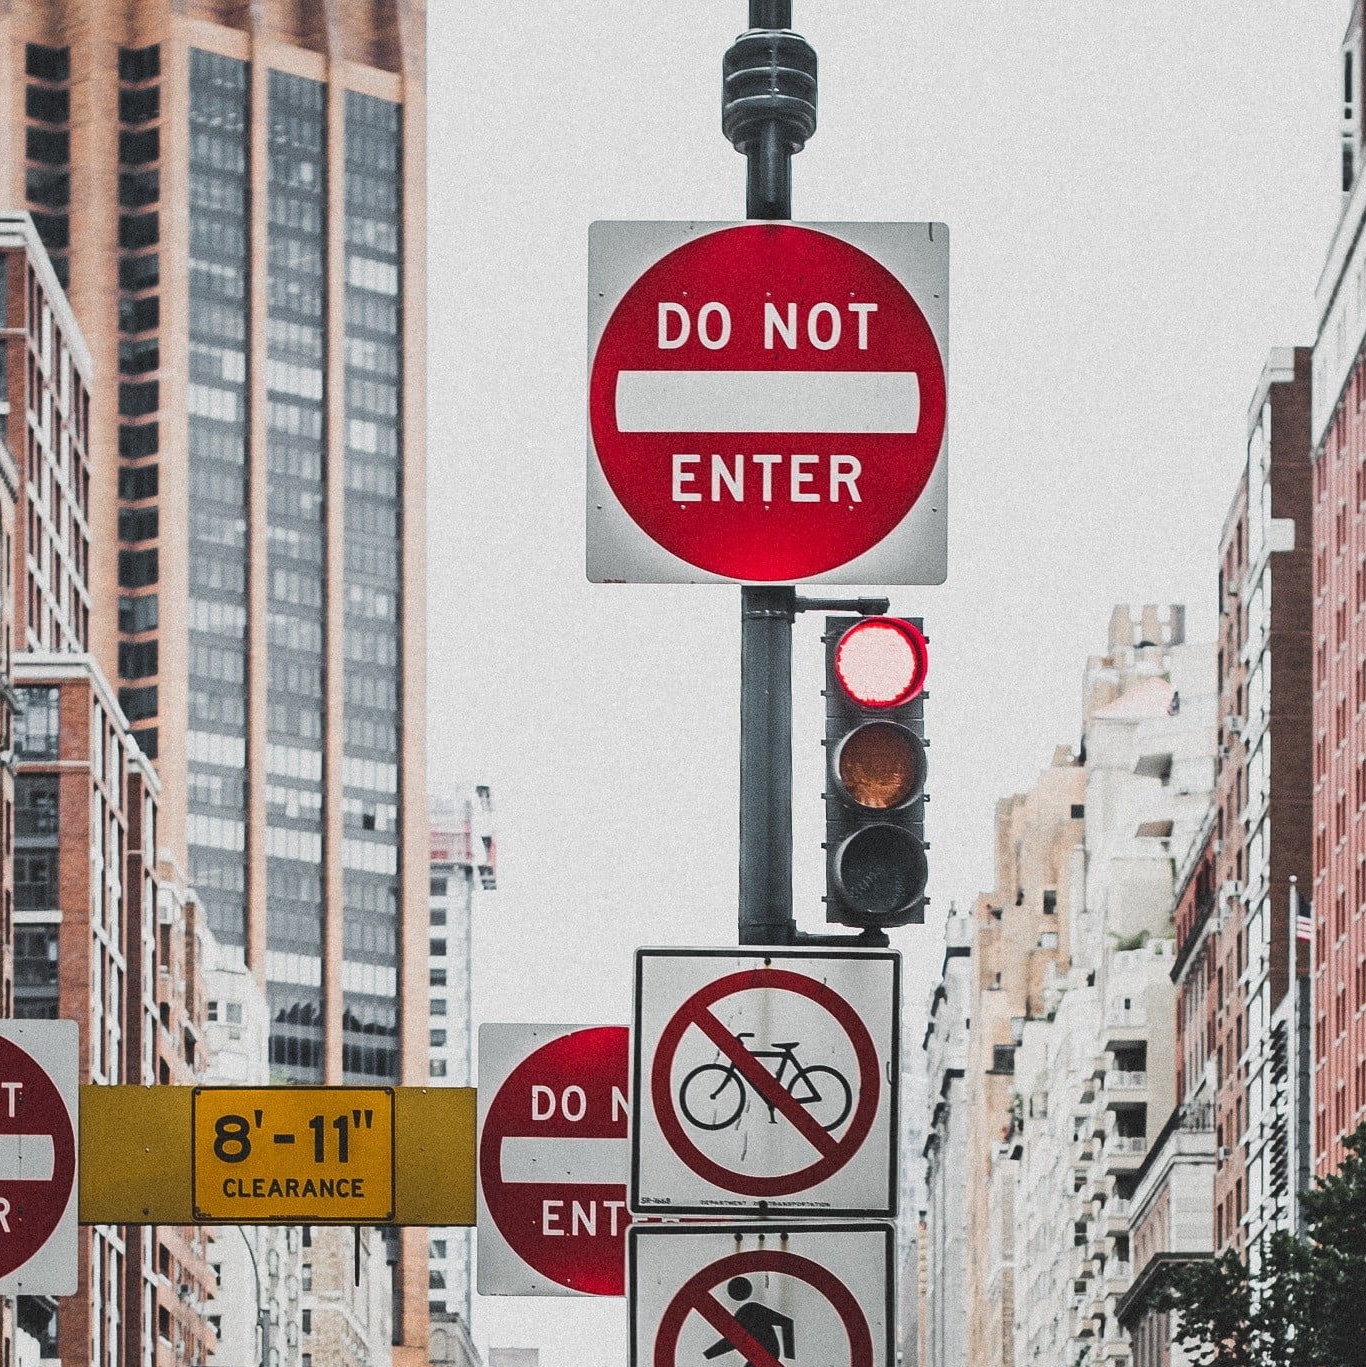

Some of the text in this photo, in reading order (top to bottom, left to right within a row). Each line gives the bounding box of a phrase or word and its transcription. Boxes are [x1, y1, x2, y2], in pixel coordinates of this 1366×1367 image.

[657, 302, 878, 350] DO NOT
[671, 454, 863, 502] ENTER
[531, 1085, 586, 1122] DO
[222, 1178, 365, 1199] CLEARANCE
[541, 1200, 620, 1237] ENT
